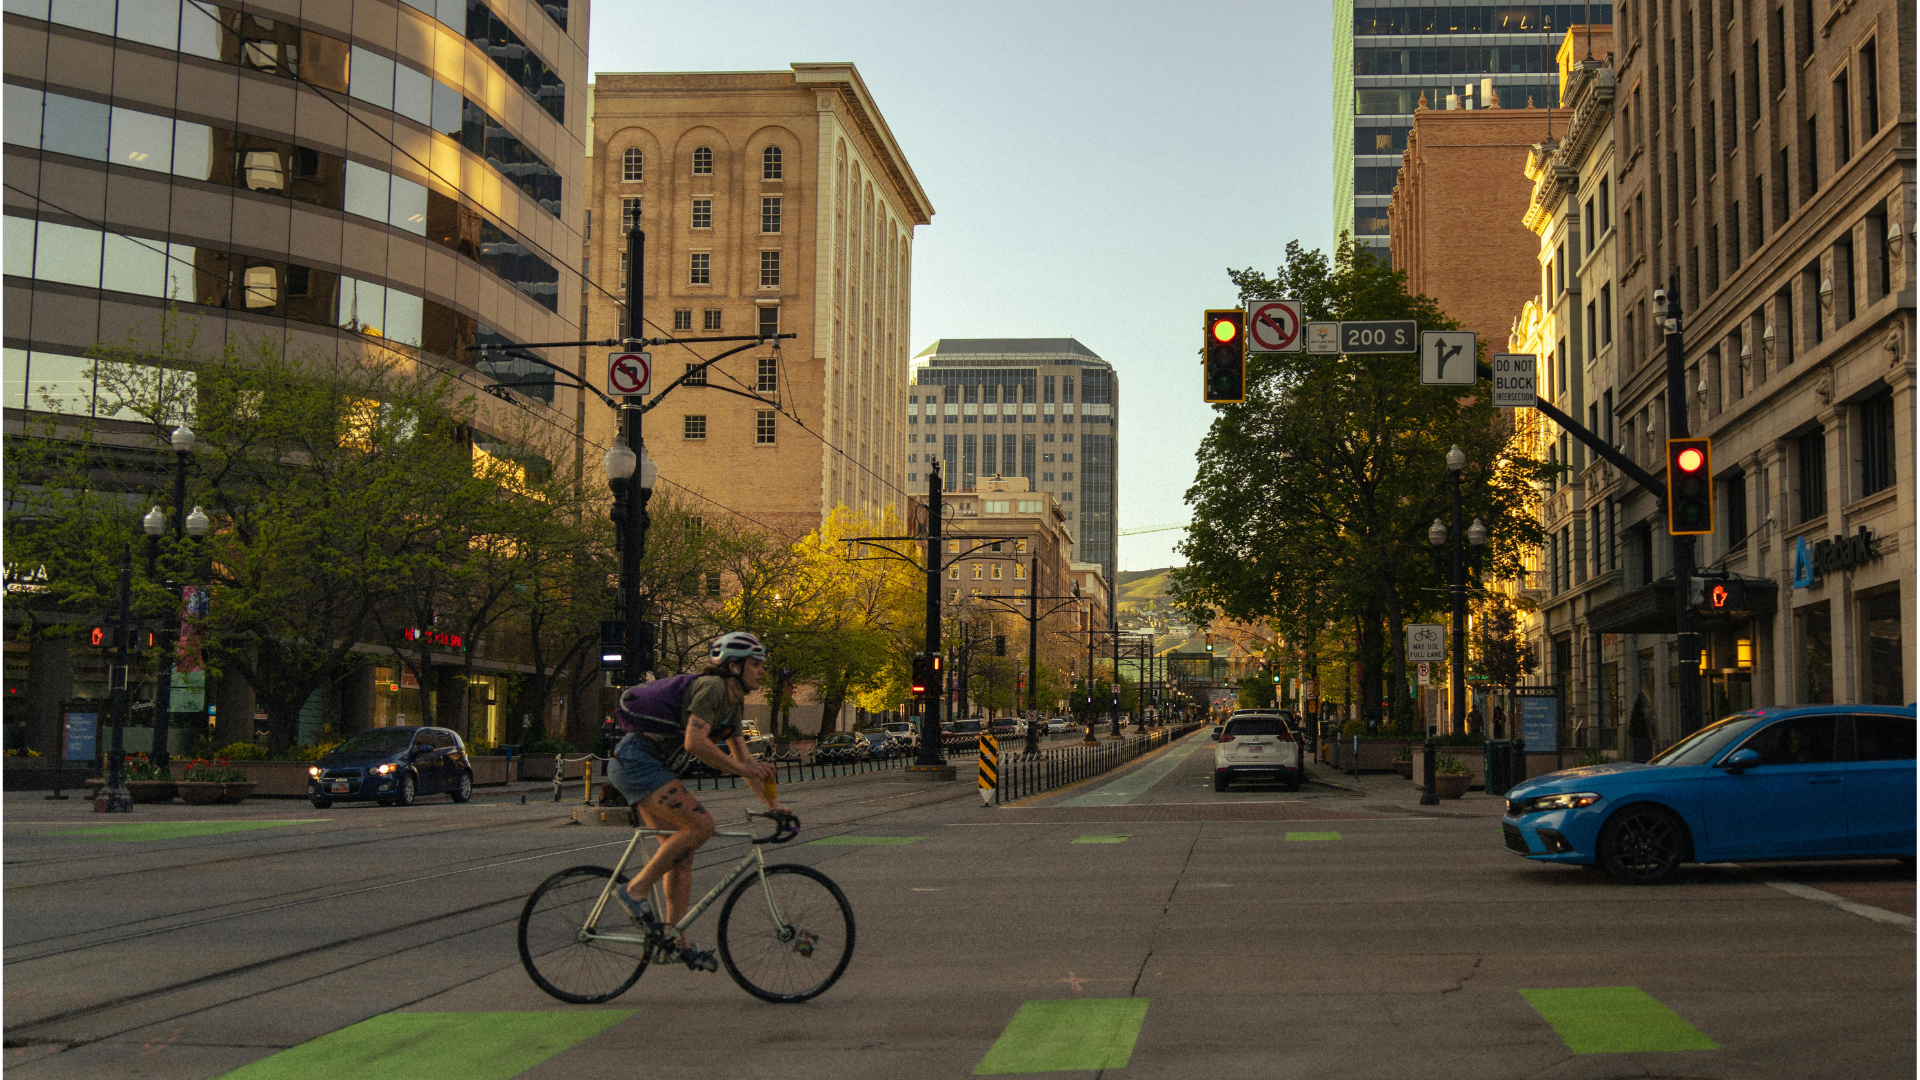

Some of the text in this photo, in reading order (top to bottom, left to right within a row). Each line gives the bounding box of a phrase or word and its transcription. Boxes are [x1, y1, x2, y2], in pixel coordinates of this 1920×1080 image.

[1348, 328, 1409, 345] 200 S.
[1496, 359, 1533, 371] DO NOT
[1496, 377, 1533, 389] BLOCK
[1496, 393, 1534, 401] INTERSECTION
[450, 635, 462, 647] SPA
